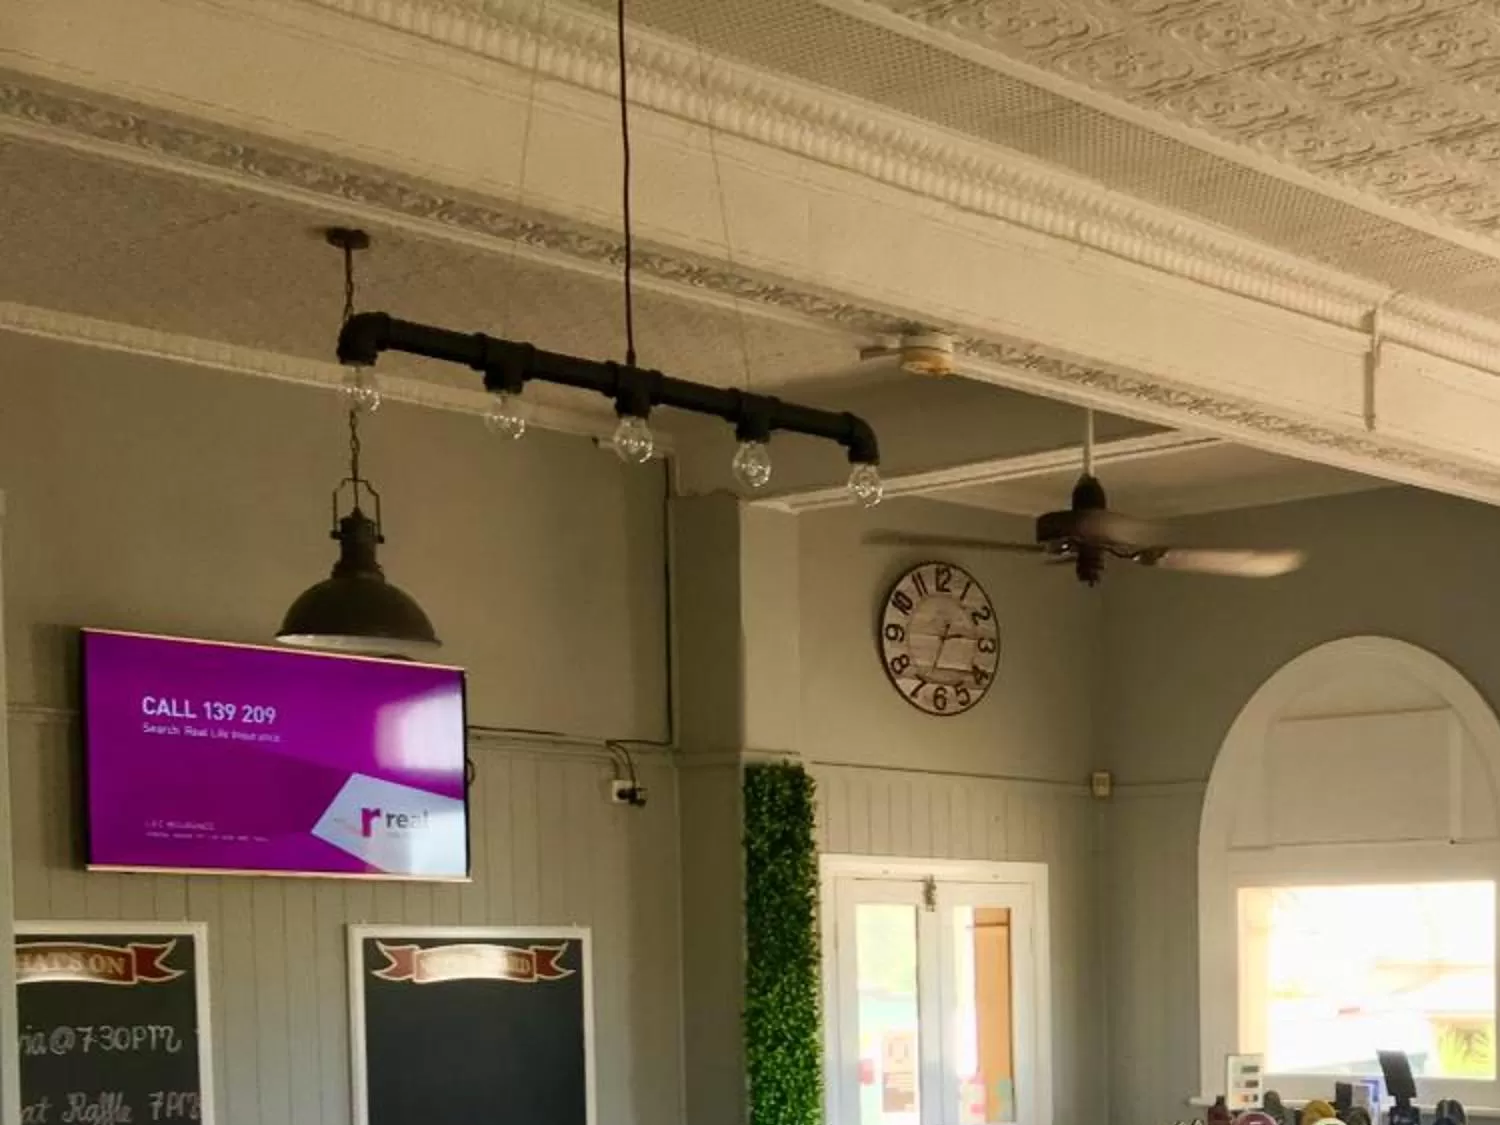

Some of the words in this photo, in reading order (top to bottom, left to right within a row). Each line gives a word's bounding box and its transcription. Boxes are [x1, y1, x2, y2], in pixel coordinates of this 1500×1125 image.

[911, 571, 929, 597] 11
[935, 567, 952, 592] 12
[960, 580, 973, 602] 1
[891, 590, 914, 616] 10
[971, 605, 991, 626] 2
[884, 623, 905, 642] 9
[977, 637, 996, 654] 3
[889, 653, 911, 675] 8
[971, 664, 990, 685] 4
[910, 673, 928, 699] 7
[933, 685, 947, 711] 6
[954, 680, 971, 707] 5
[142, 695, 197, 720] CALL
[203, 701, 237, 722] 139
[241, 704, 276, 725] 209
[89, 953, 125, 977] ON
